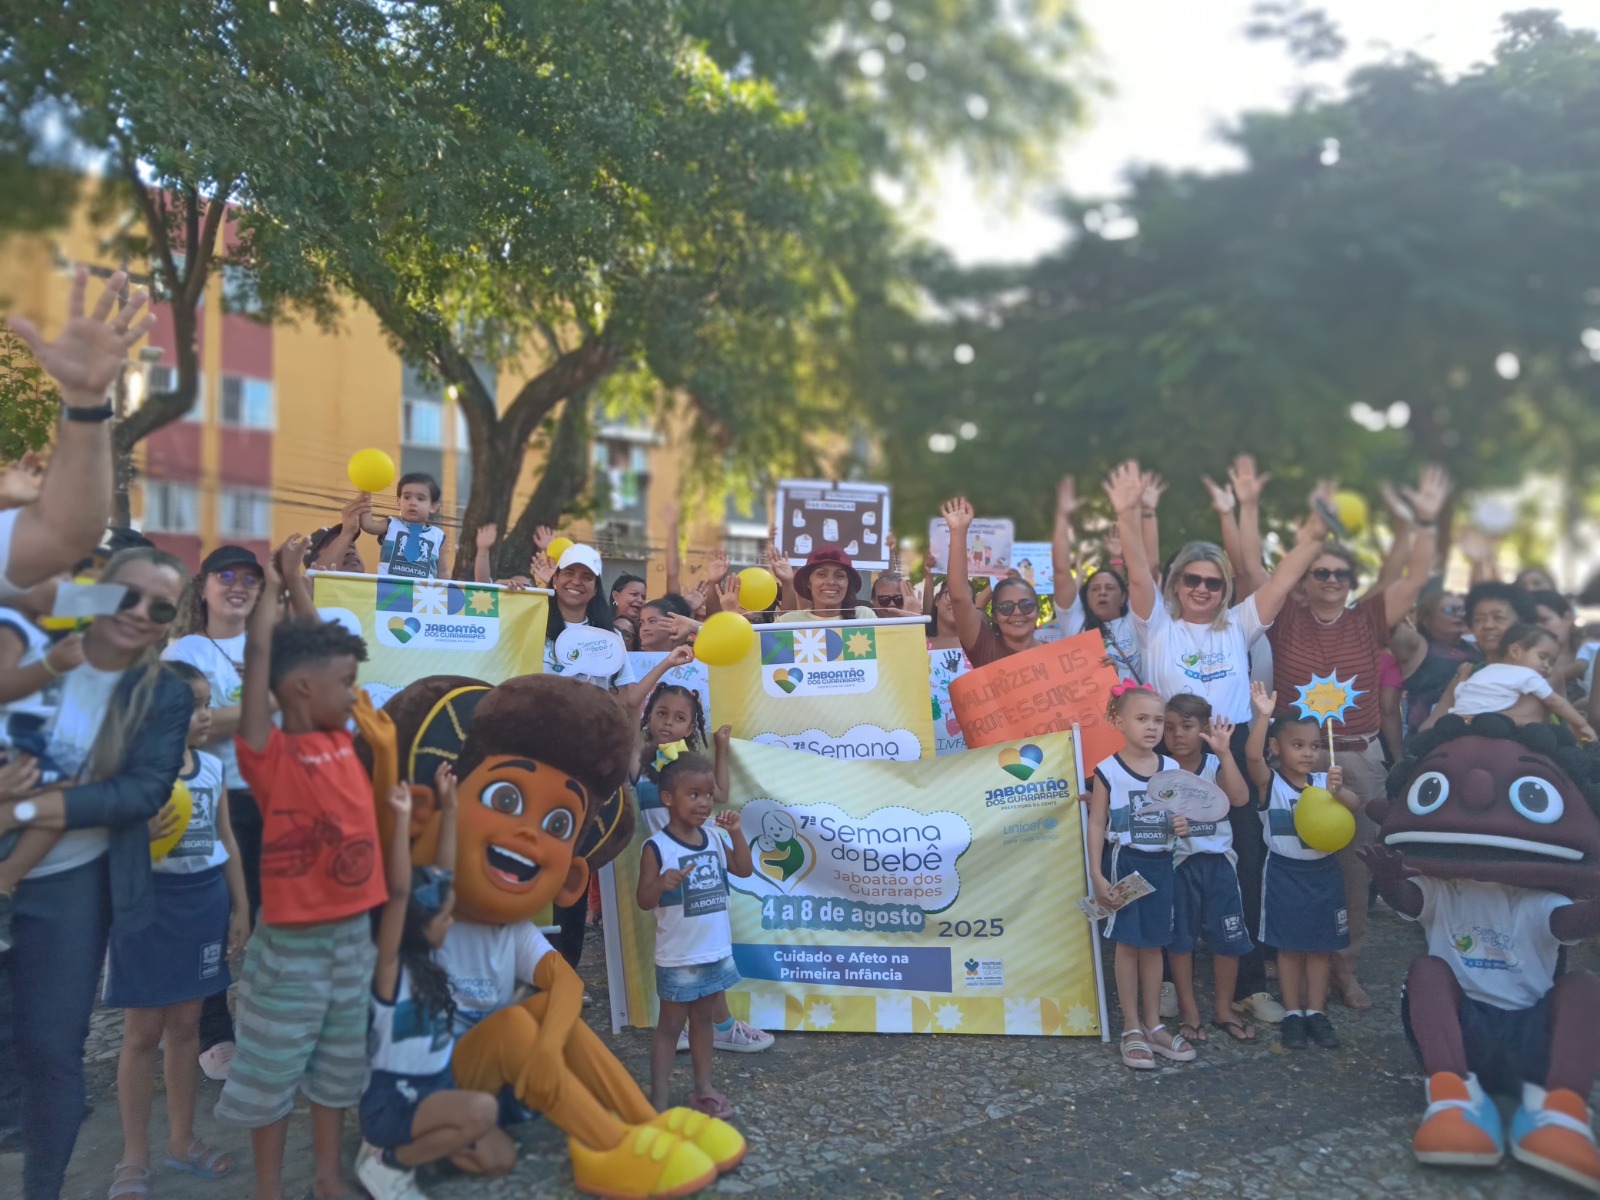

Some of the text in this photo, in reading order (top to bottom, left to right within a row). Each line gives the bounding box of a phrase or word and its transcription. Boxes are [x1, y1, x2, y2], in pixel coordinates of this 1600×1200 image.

[424, 624, 486, 634] JABOATÃO
[440, 632, 486, 640] GUARARAPES
[1058, 648, 1089, 674] OS
[807, 667, 865, 680] JABOATÃO
[822, 677, 866, 685] GUARARAPES
[965, 676, 1100, 742] PROFESSORES
[808, 741, 899, 758] Semana
[985, 776, 1068, 801] JABOATÃO
[986, 790, 1070, 808] DOS GUARARAPES
[800, 816, 941, 844] 7ª Semana
[1004, 818, 1042, 834] unicef
[831, 843, 942, 872] do Bebê
[834, 870, 942, 885] Jaboatão dos
[849, 884, 942, 899] Guararapes
[762, 899, 922, 928] 4 a 8 de agosto
[938, 918, 1005, 938] 2025
[774, 950, 909, 964] Cuidado e Afeto na
[780, 967, 903, 981] Primeira Infância
